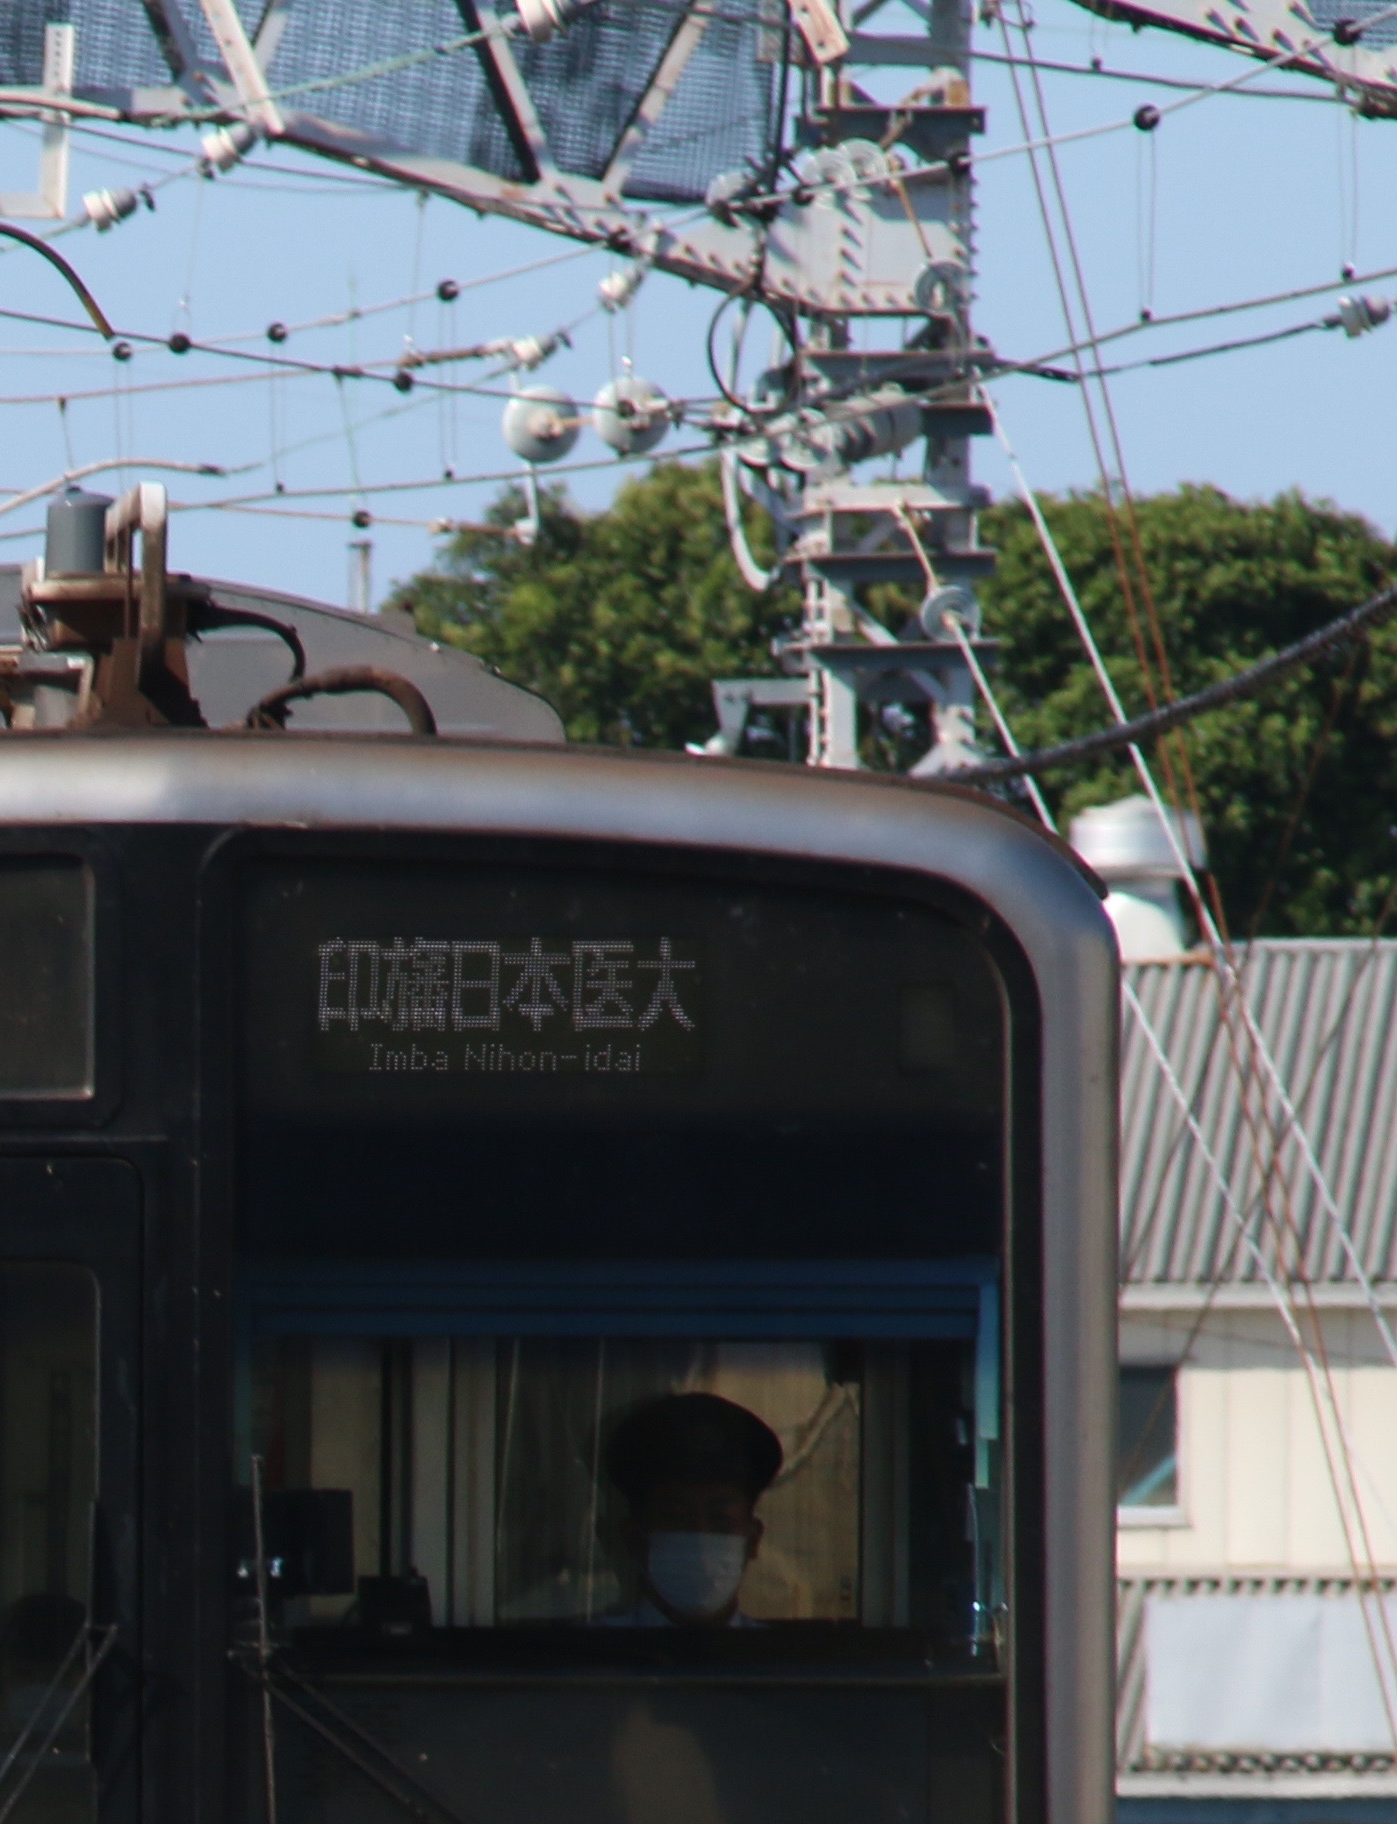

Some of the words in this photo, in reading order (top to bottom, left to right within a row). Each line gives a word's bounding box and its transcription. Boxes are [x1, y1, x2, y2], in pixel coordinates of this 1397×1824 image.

[317, 936, 697, 1031] 印旛日本医大
[369, 1043, 449, 1071] Imba
[463, 1043, 643, 1071] Nihon-idai
